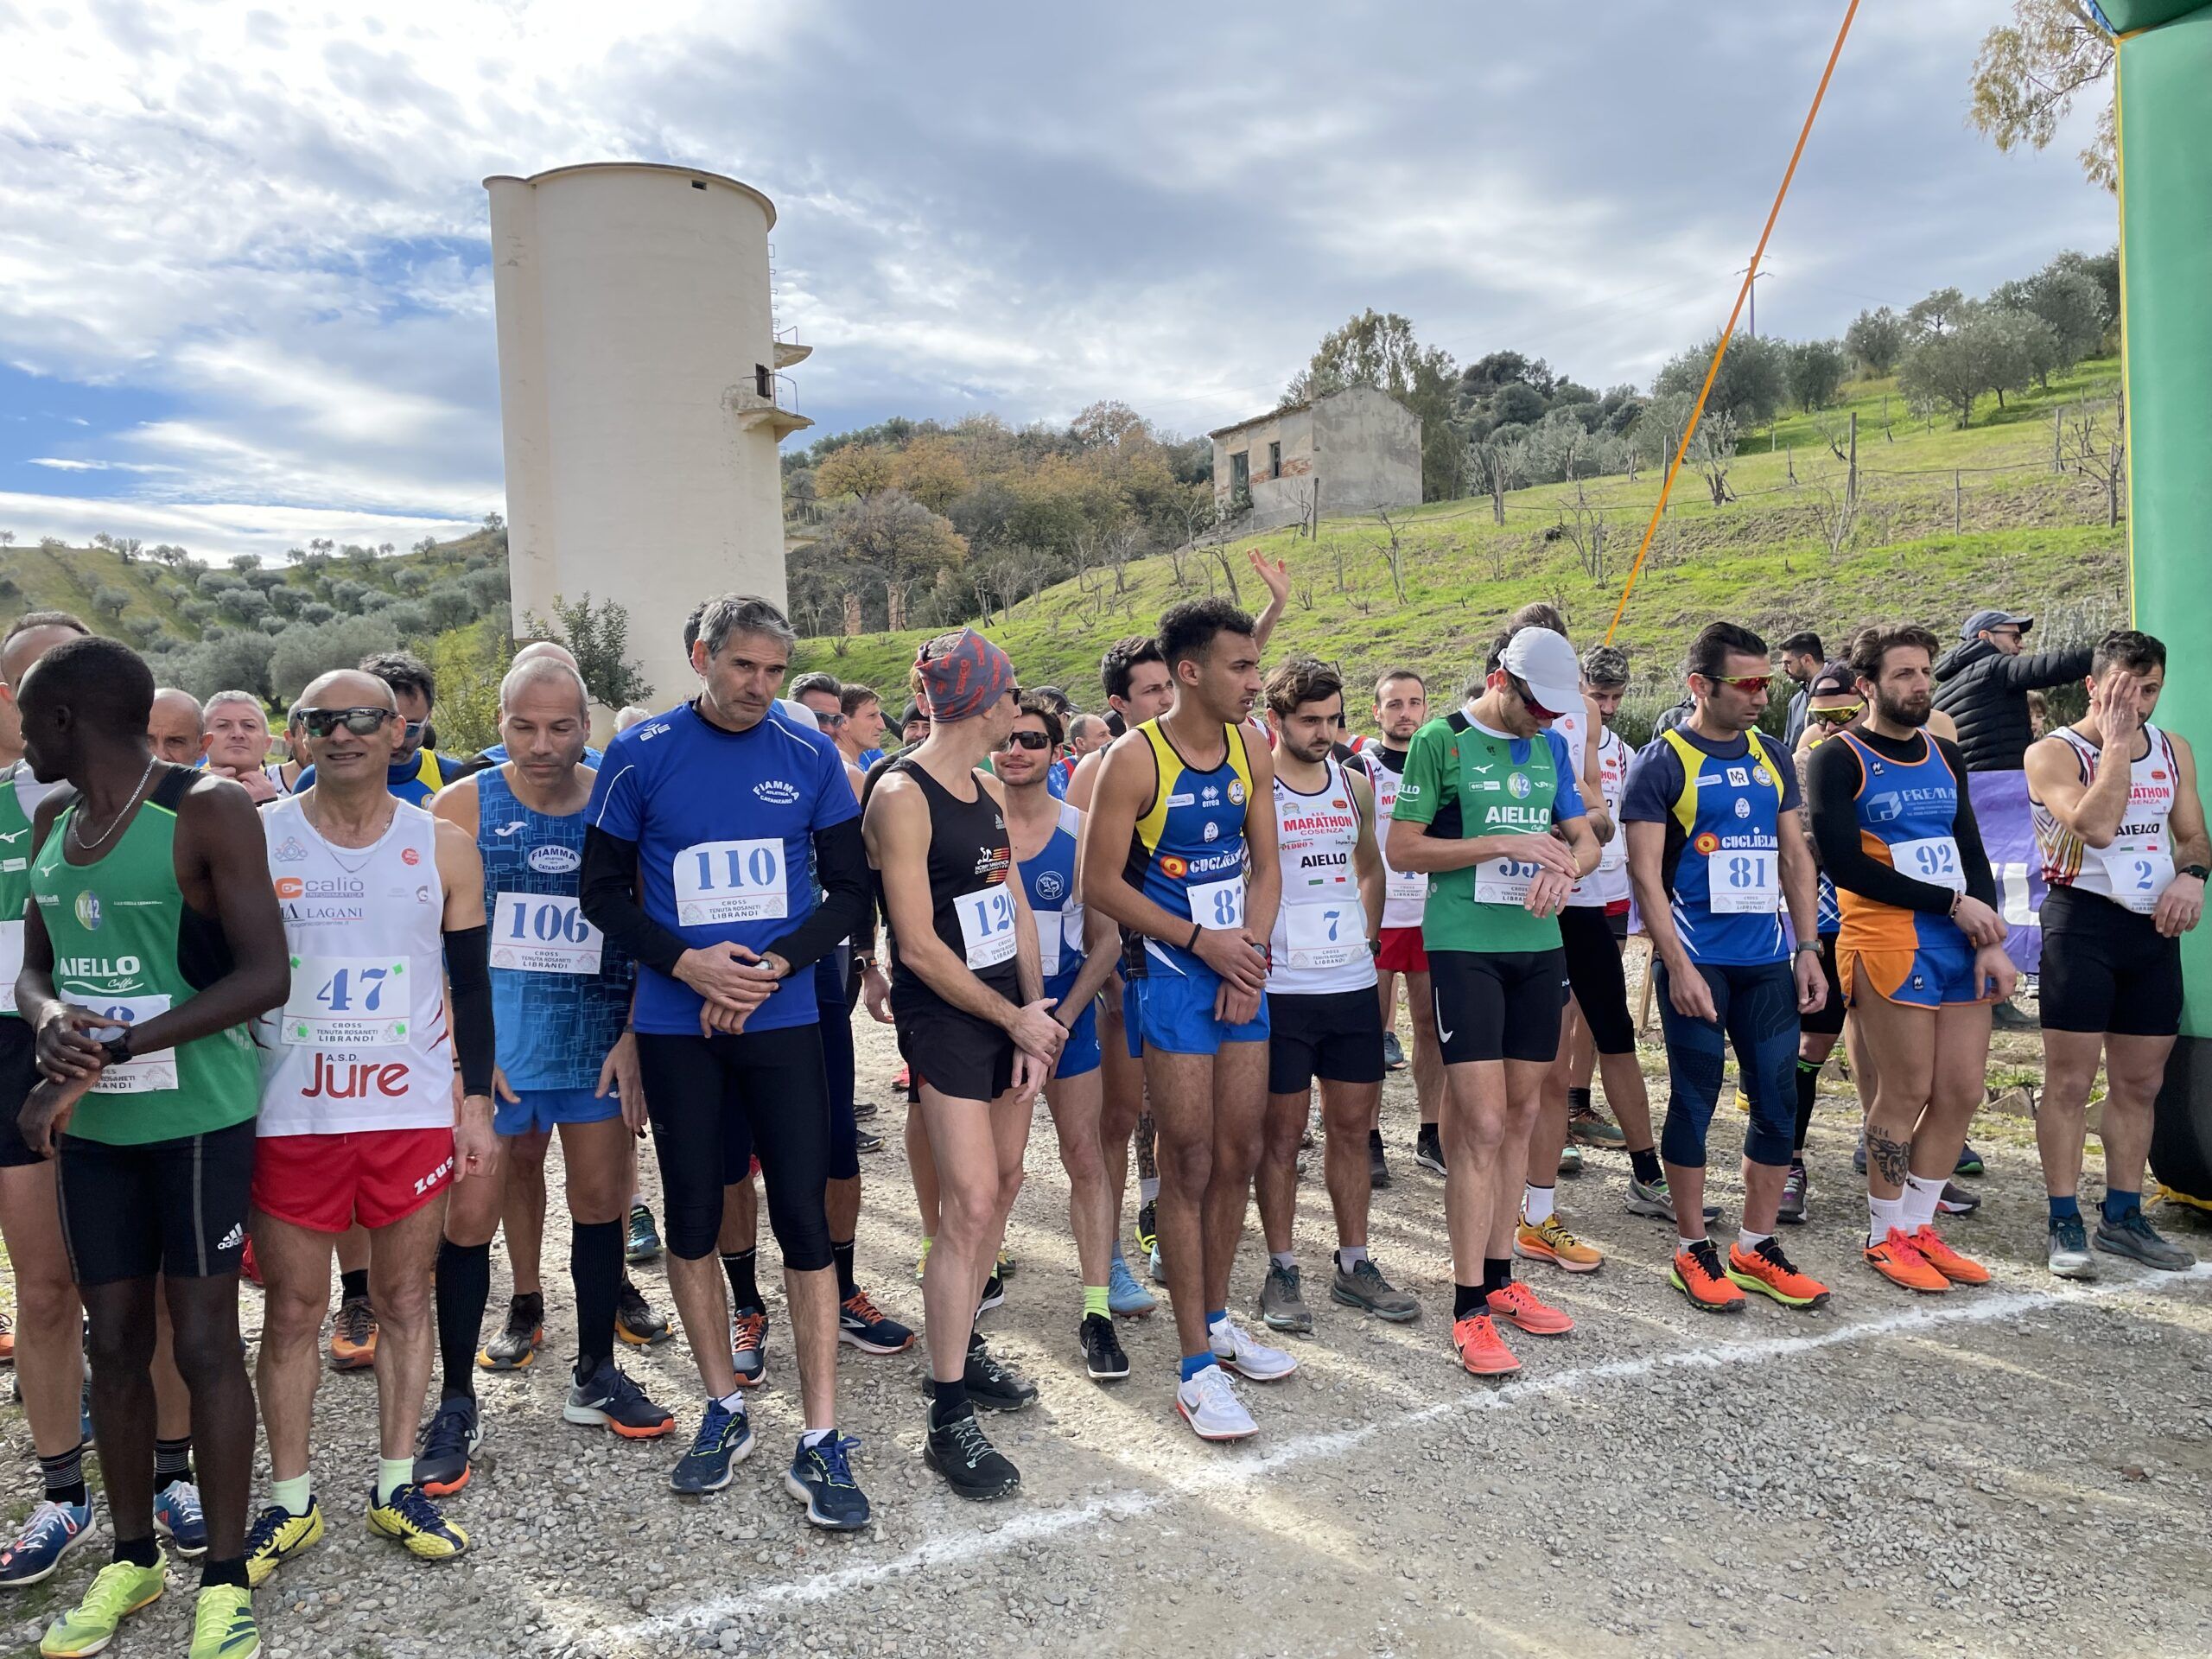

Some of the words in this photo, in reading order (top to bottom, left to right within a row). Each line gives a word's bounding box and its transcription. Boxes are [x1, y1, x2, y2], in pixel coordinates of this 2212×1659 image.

[1509, 779, 1529, 791] K42
[1730, 771, 1746, 783] MR
[753, 780, 800, 800] FIAMMA
[760, 795, 793, 804] CATANZARO
[2129, 787, 2170, 799] ATHON
[1283, 816, 1353, 832] MARATHON
[1484, 805, 1550, 825] AIELLO
[1300, 827, 1344, 836] COSENZA
[2114, 823, 2160, 837] AIELLO
[531, 848, 576, 862] FIAMMA
[1300, 852, 1347, 868] AIELLO
[1916, 843, 1952, 876] 92
[695, 847, 777, 891] 110
[1729, 856, 1765, 887] 81
[2134, 860, 2153, 890] 2
[79, 899, 100, 918] K42
[307, 907, 363, 918] LAGANI
[712, 910, 758, 920] LIBRANDI
[509, 902, 589, 944] 106
[1323, 911, 1340, 942] 7
[60, 956, 140, 977] AIELLO
[316, 968, 388, 1012] 47
[326, 1053, 359, 1062] A.S.D.
[301, 1052, 410, 1099] Jure
[414, 1156, 454, 1196] Zeus
